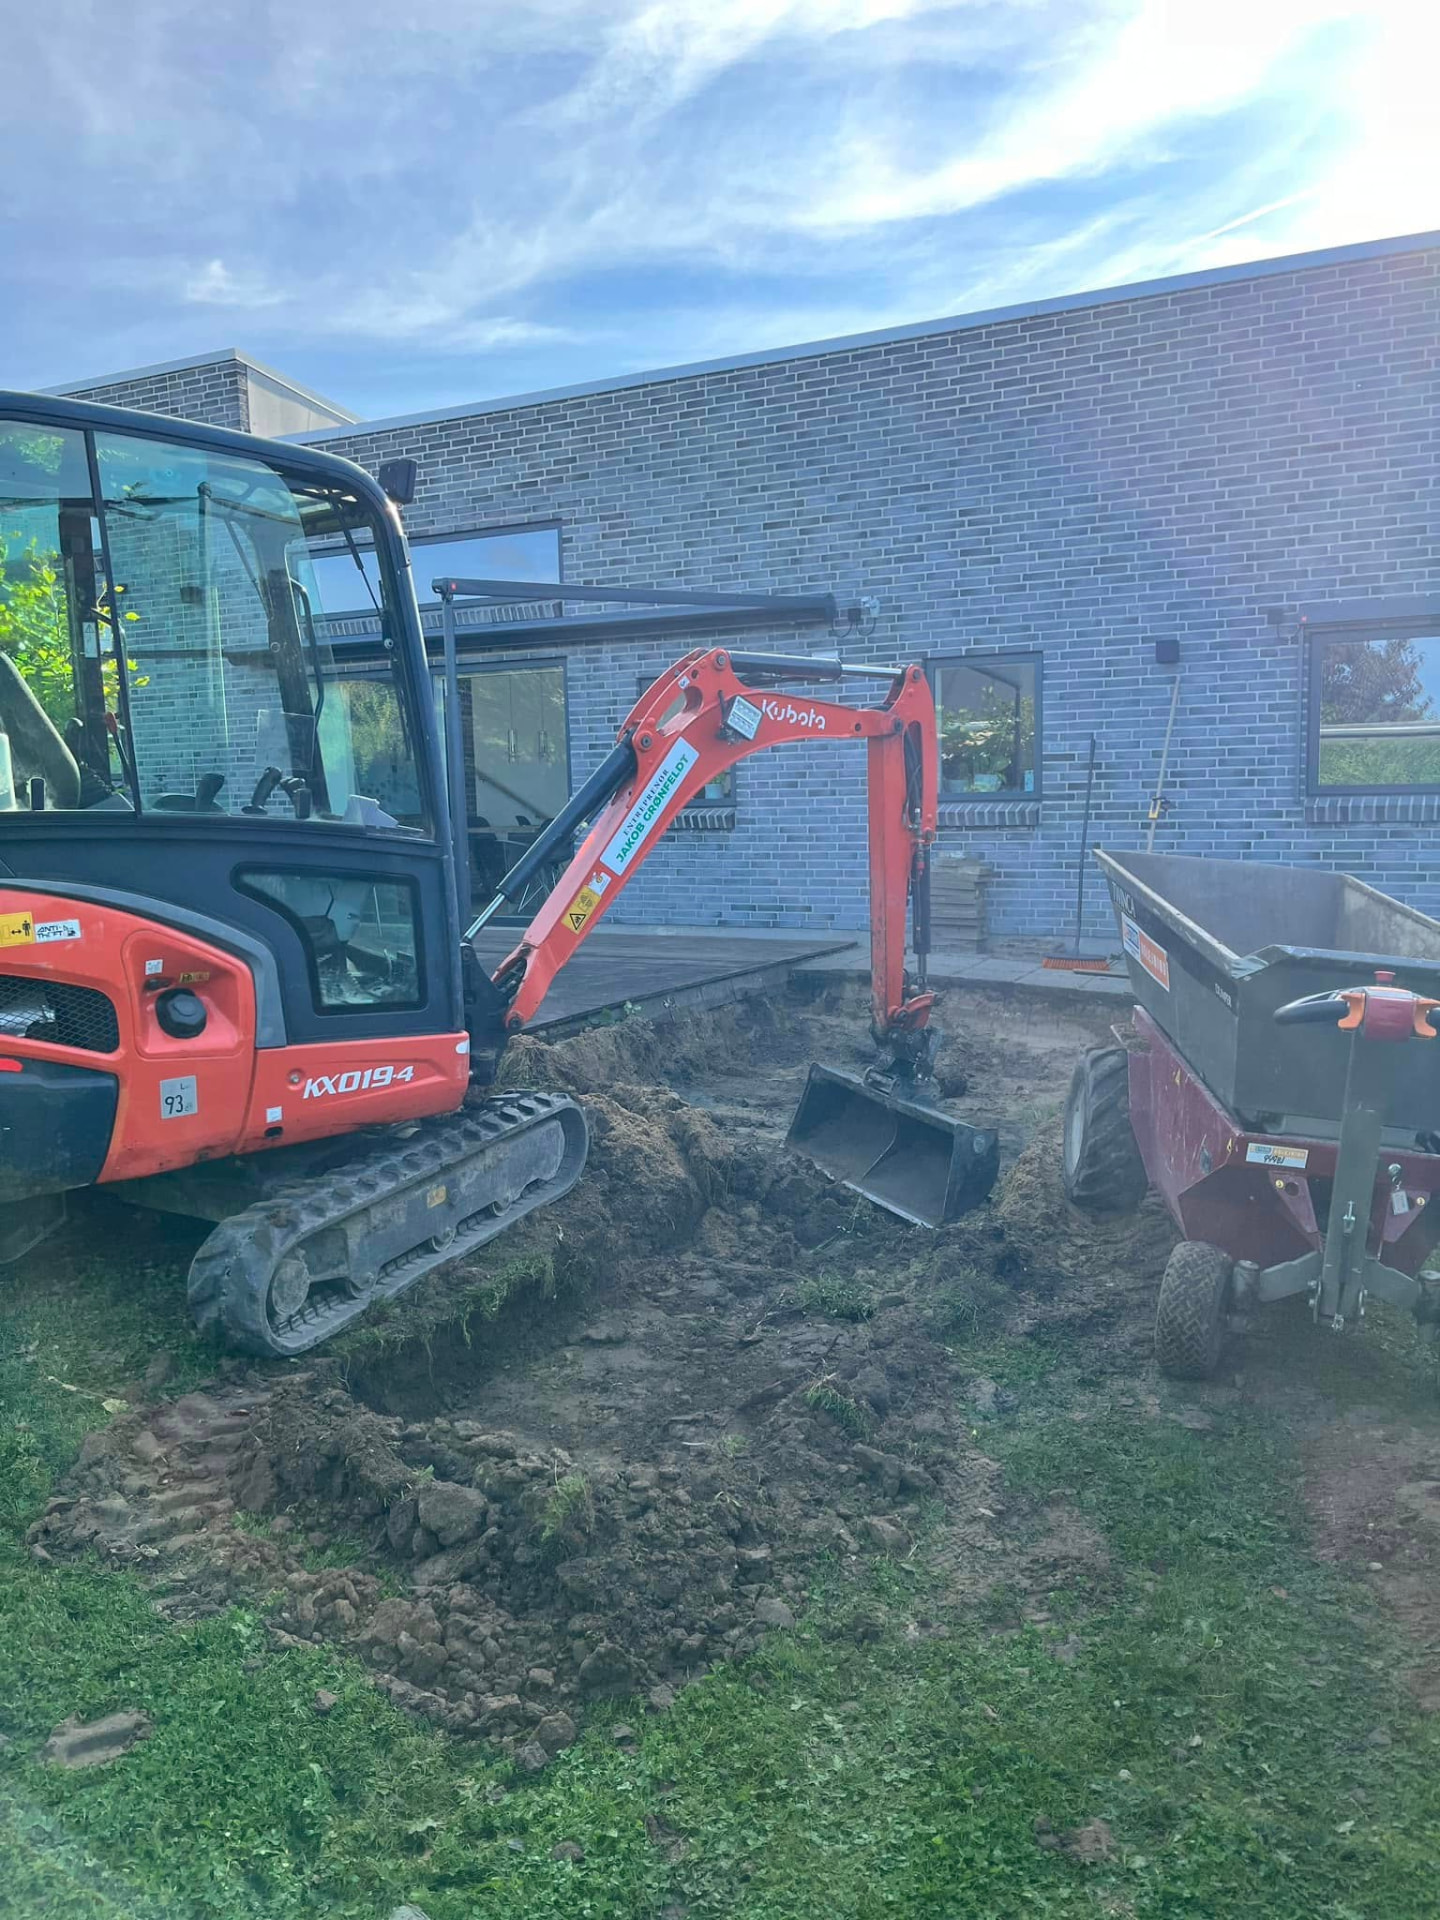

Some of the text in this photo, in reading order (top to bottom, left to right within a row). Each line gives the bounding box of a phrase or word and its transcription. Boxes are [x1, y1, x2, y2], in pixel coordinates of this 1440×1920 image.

[762, 699, 826, 730] Kubota
[616, 754, 689, 862] JAKOB GRØNFELDT
[624, 769, 669, 836] ENTREPRENØR
[302, 1065, 415, 1099] KX019-4
[164, 1094, 184, 1115] 93
